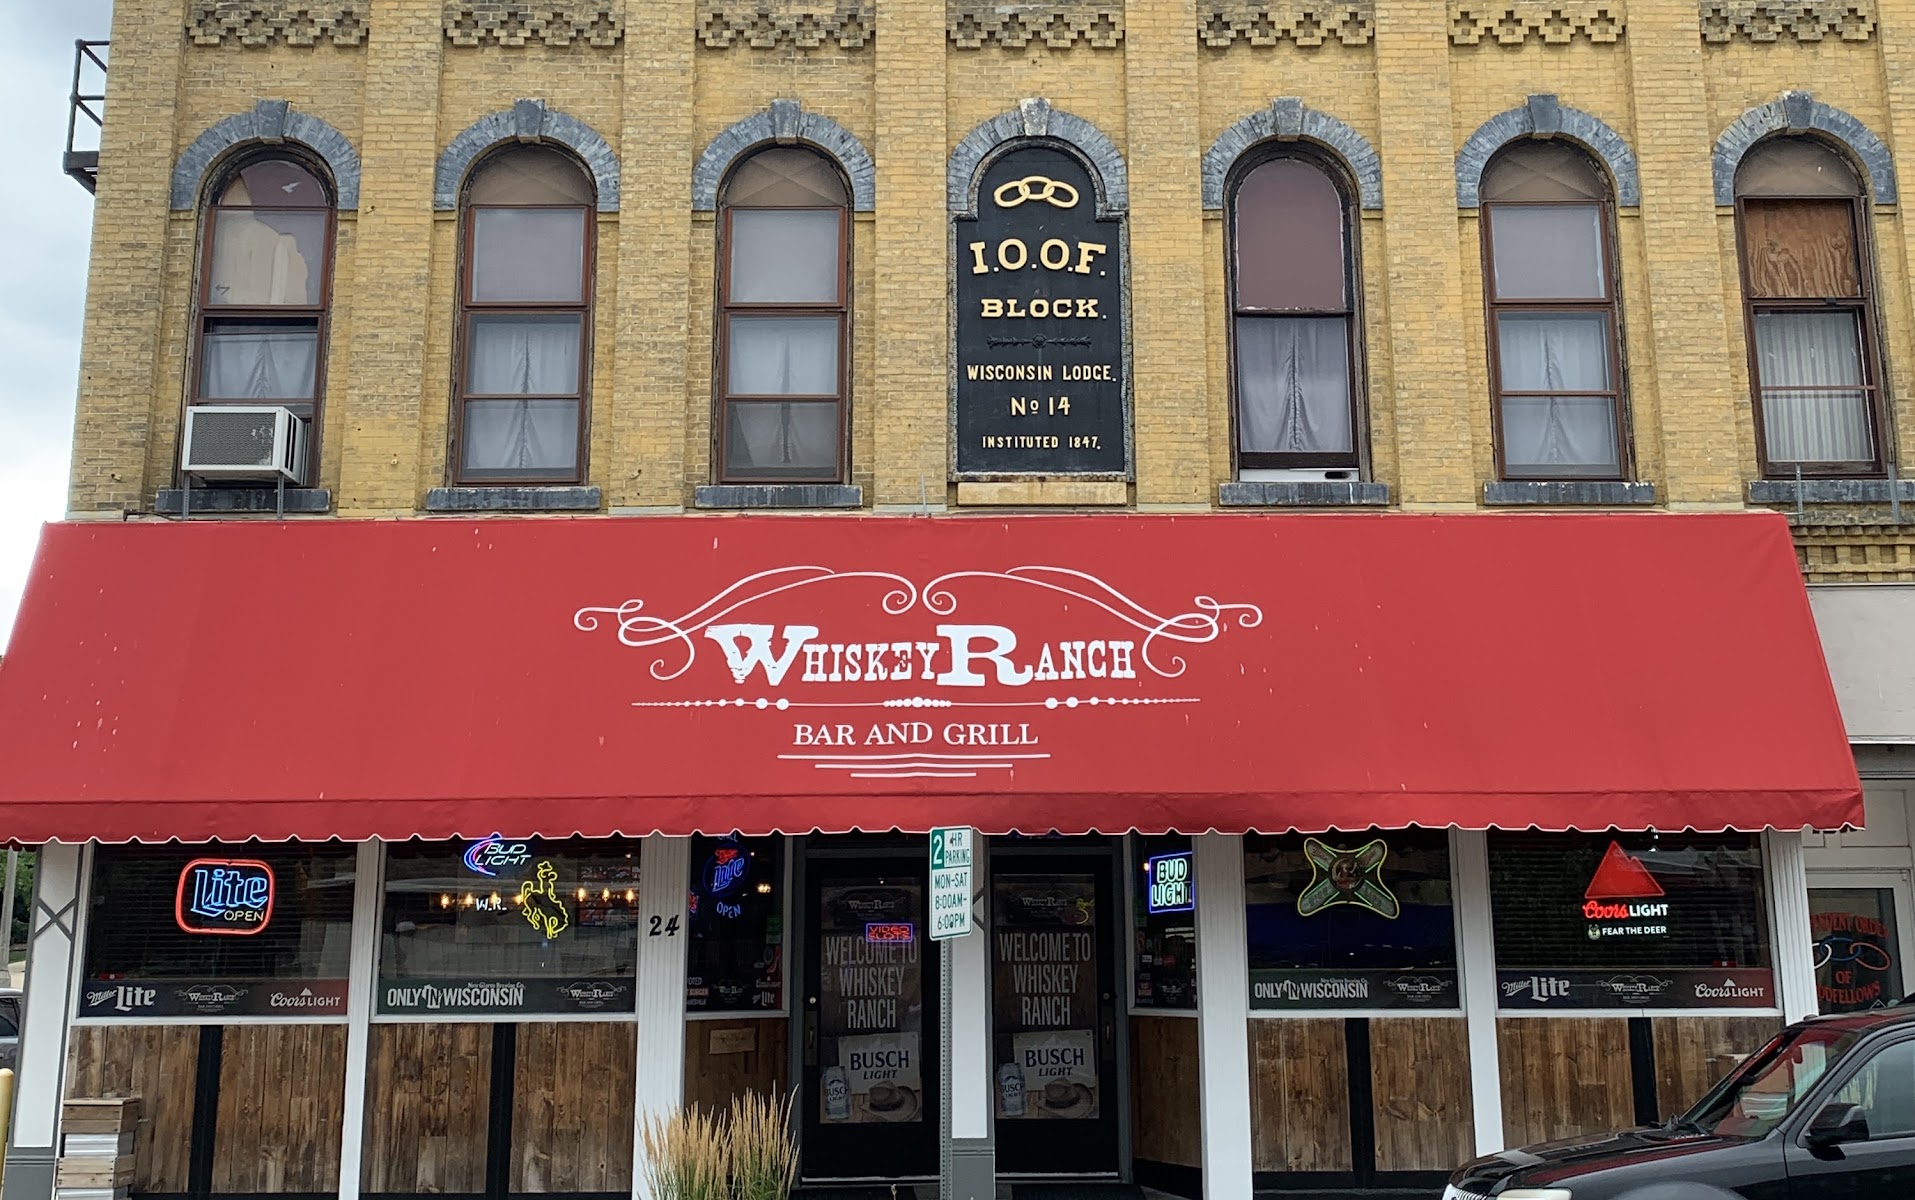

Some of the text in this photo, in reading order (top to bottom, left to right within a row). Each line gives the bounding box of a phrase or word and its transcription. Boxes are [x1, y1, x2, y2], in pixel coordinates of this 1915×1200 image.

[981, 299, 1107, 320] BLOCK.
[967, 365, 1117, 382] WISCONSIN LODGE.
[1049, 397, 1070, 416] 14
[982, 436, 1101, 450] INSTITUTED 1847.
[793, 721, 1039, 746] BAR AND GRILL
[484, 843, 527, 855] BUD
[933, 832, 963, 866] 2 HR
[945, 848, 970, 866] PARKING
[474, 854, 532, 866] LIGHT
[1156, 858, 1188, 883] BUD
[934, 871, 968, 890] MON-SAT
[190, 868, 268, 917] Lite
[1151, 882, 1192, 907] LIGHT
[224, 910, 264, 922] OPEN
[716, 901, 741, 919] OPEN
[1582, 900, 1669, 919] Coors LIGHT
[649, 915, 680, 937] 24
[937, 912, 965, 931] 6:00PM
[1602, 925, 1667, 936] FEAR THE DEER
[868, 932, 911, 941] SLOTS
[825, 935, 896, 966] WELCOME
[1000, 932, 1091, 963] WELCOME TO
[688, 977, 703, 986] OTED
[839, 966, 905, 997] WHISKEY
[1013, 964, 1079, 995] WHISKEY
[1834, 970, 1853, 985] OF
[387, 988, 422, 1007] ONLY
[442, 988, 525, 1007] WISCONSIN
[1254, 982, 1282, 999] ONLY
[1300, 982, 1368, 999] WISCONSIN
[1530, 975, 1570, 1001] Lite
[1694, 982, 1764, 999] Coors LIGHT
[1818, 980, 1881, 1004] DDFELLOWS
[114, 985, 157, 1012] Lite
[270, 992, 340, 1009] Coors LIGHT
[847, 999, 897, 1030] RANCH
[1022, 996, 1071, 1026] RANCH
[850, 1050, 909, 1072] BUSCH
[1025, 1047, 1085, 1069] BUSCH
[863, 1069, 899, 1080] LIGHT
[1038, 1068, 1073, 1079] LIGHT
